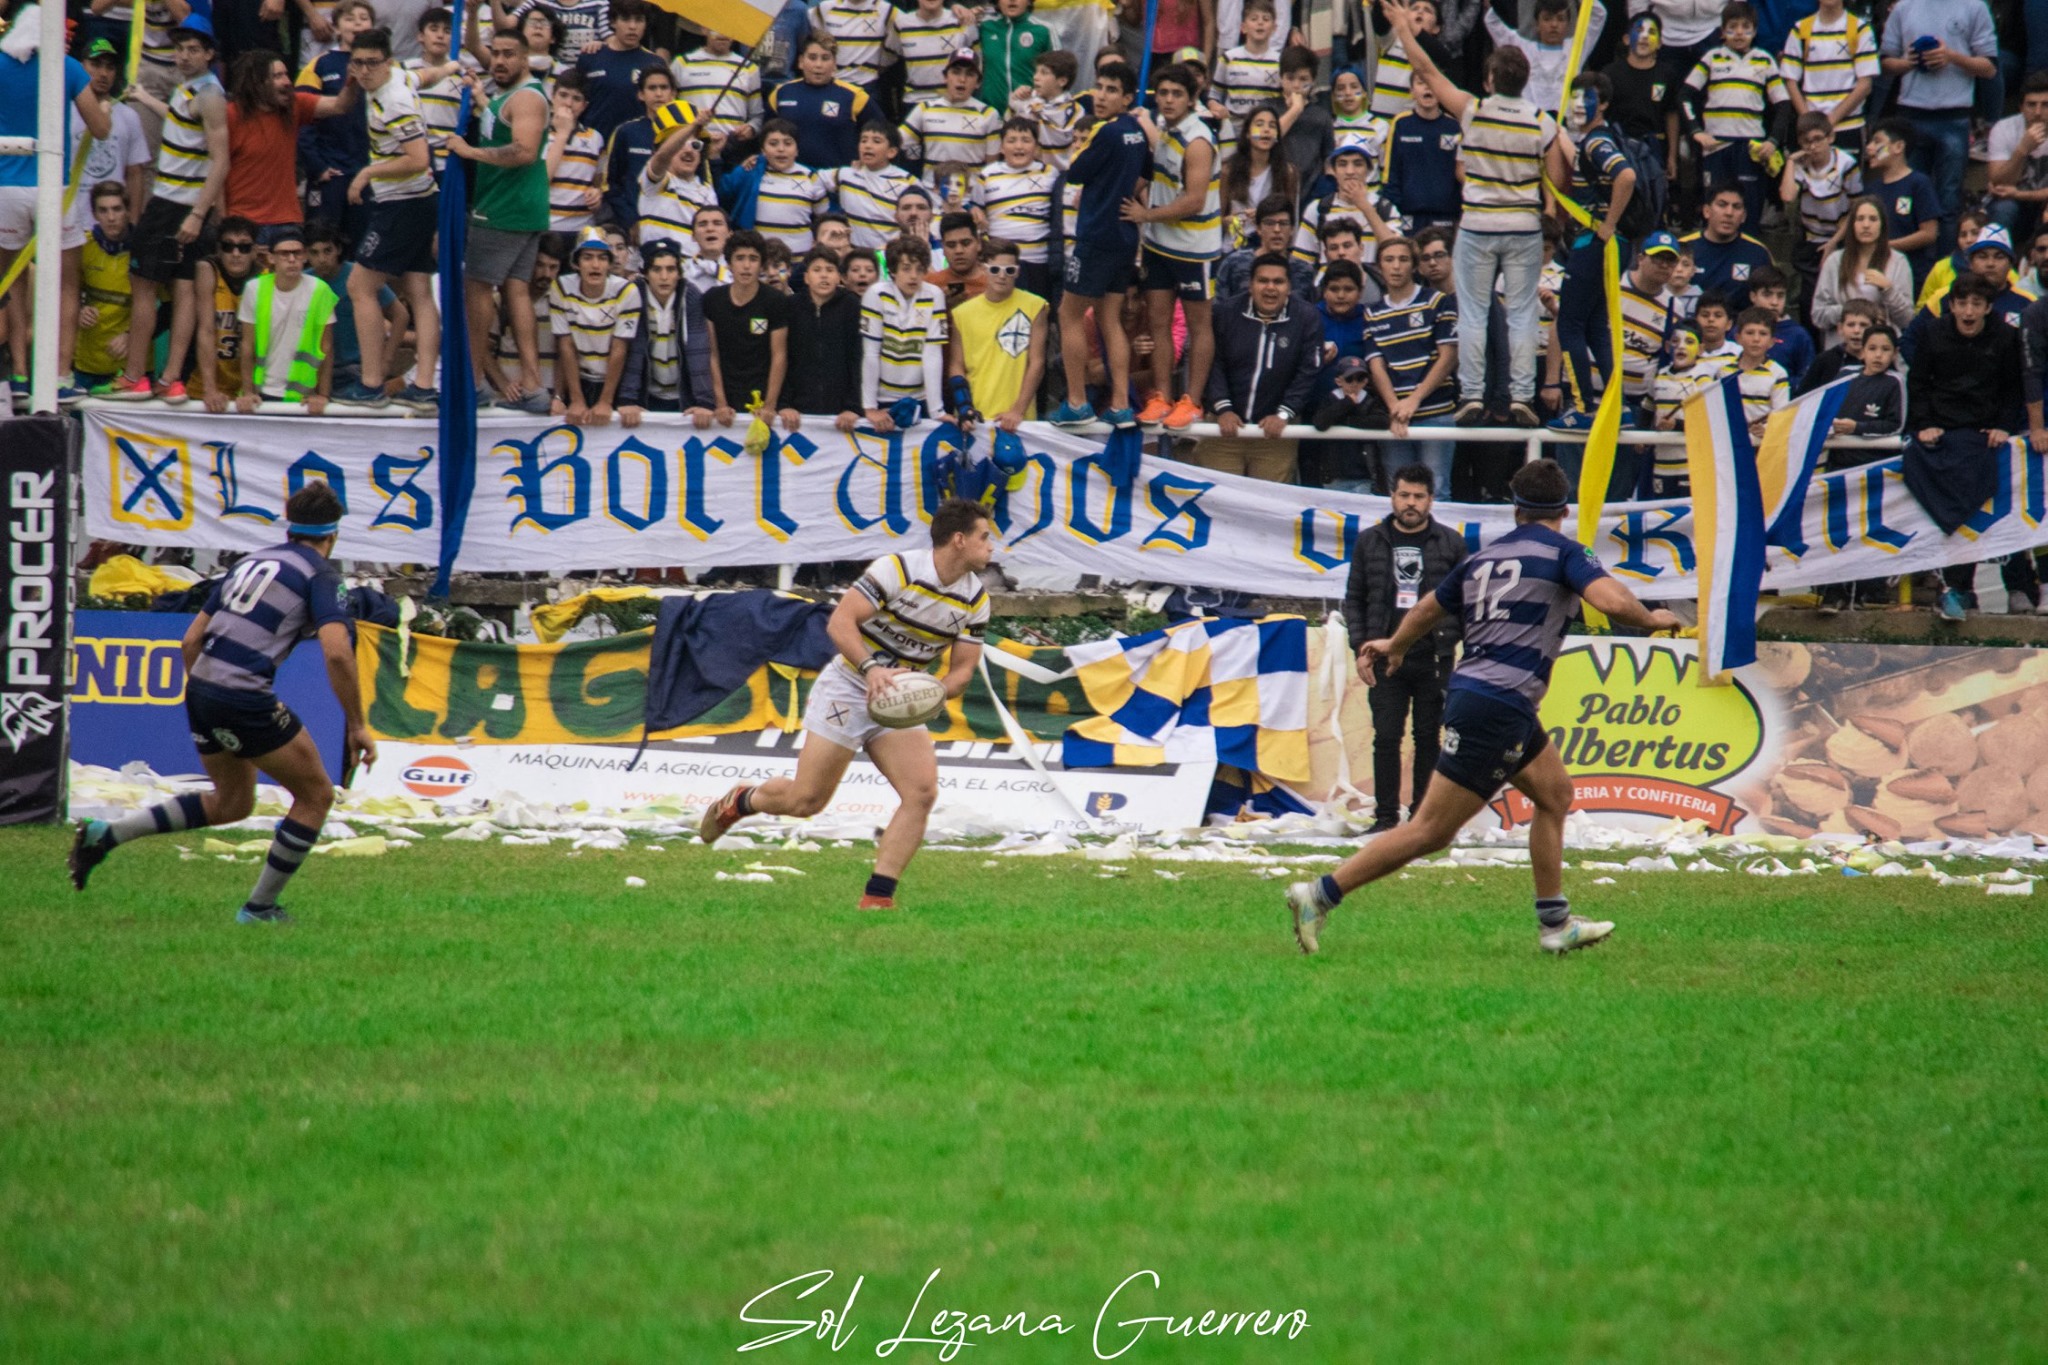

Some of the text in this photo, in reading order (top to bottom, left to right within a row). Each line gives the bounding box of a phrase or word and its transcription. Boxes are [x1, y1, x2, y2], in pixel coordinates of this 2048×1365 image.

[202, 440, 434, 534] Los
[7, 469, 55, 686] PROCER
[221, 559, 281, 615] 10
[1472, 558, 1523, 622] 12
[73, 640, 186, 701] NIO
[876, 686, 941, 710] GILBERT
[1576, 692, 1682, 726] Pablo
[403, 768, 473, 784] Gulf
[508, 752, 649, 773] MAQUINARA
[656, 761, 775, 781] AGRÍCOLAS
[965, 778, 989, 791] EL
[1613, 785, 1624, 799] Y
[1627, 786, 1718, 816] CONFITERIA
